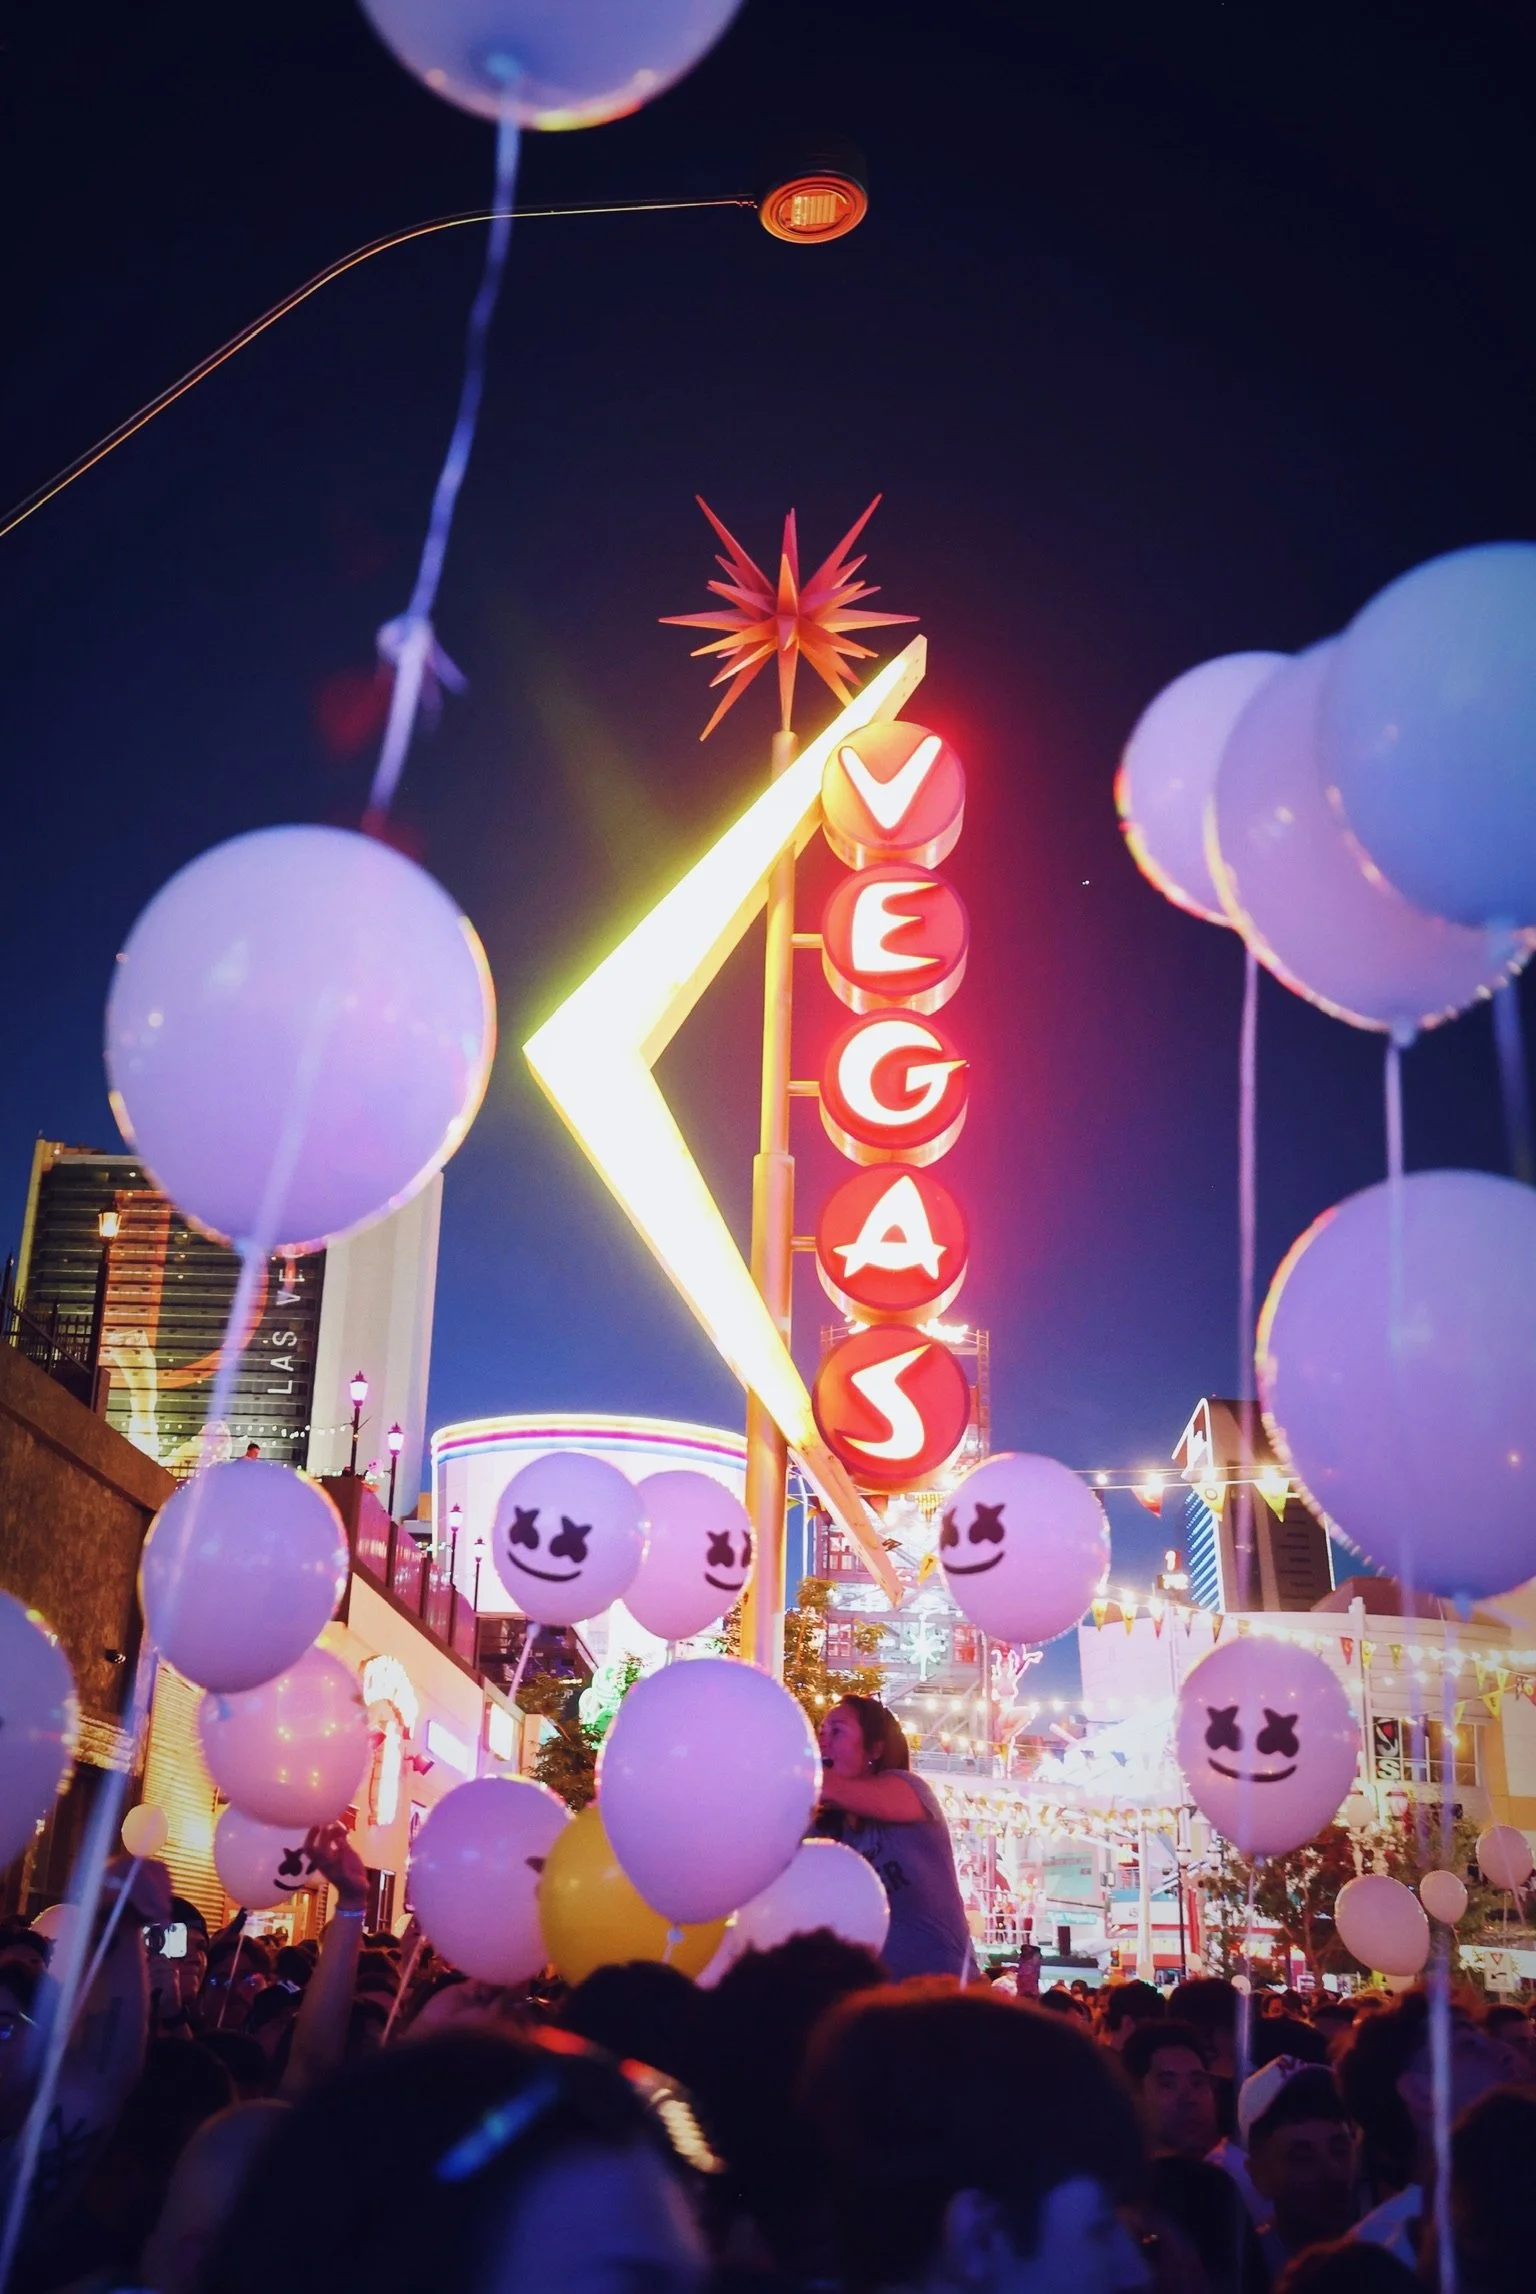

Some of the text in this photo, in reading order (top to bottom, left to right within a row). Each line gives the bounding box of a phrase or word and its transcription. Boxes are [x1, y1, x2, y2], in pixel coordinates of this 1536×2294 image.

[835, 734, 970, 1464] VEGAS
[267, 1255, 306, 1394] LAS VE
